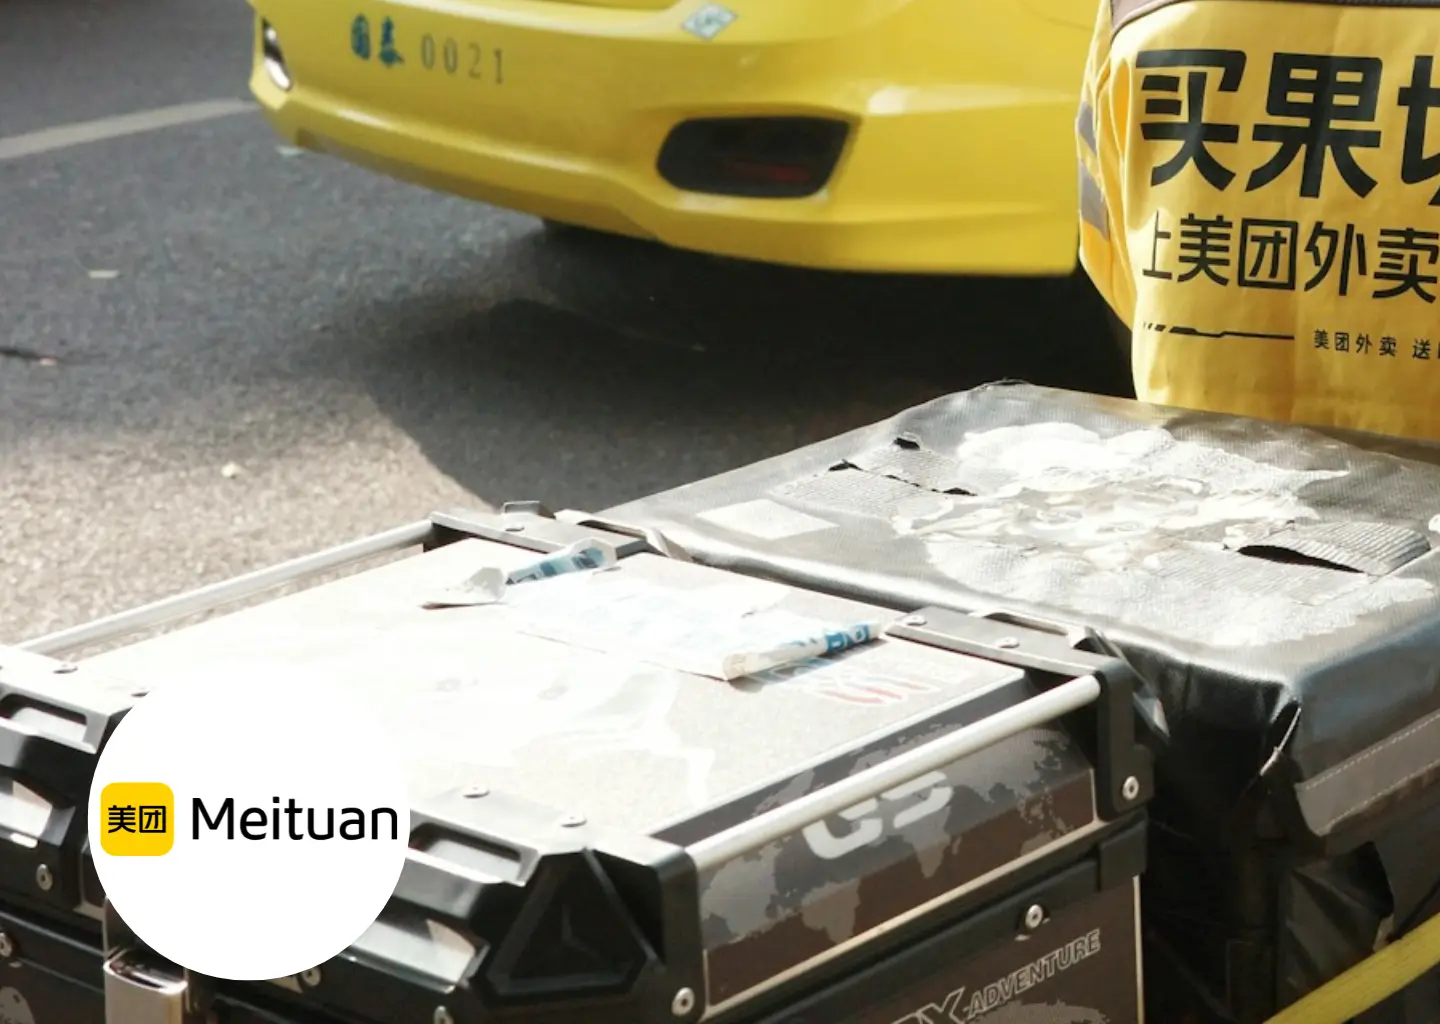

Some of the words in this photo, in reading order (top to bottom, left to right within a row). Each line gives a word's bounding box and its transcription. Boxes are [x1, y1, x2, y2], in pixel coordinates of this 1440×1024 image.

[421, 33, 504, 85] 0021
[1142, 210, 1440, 304] 上美团外卖
[1313, 328, 1398, 358] 美团外卖
